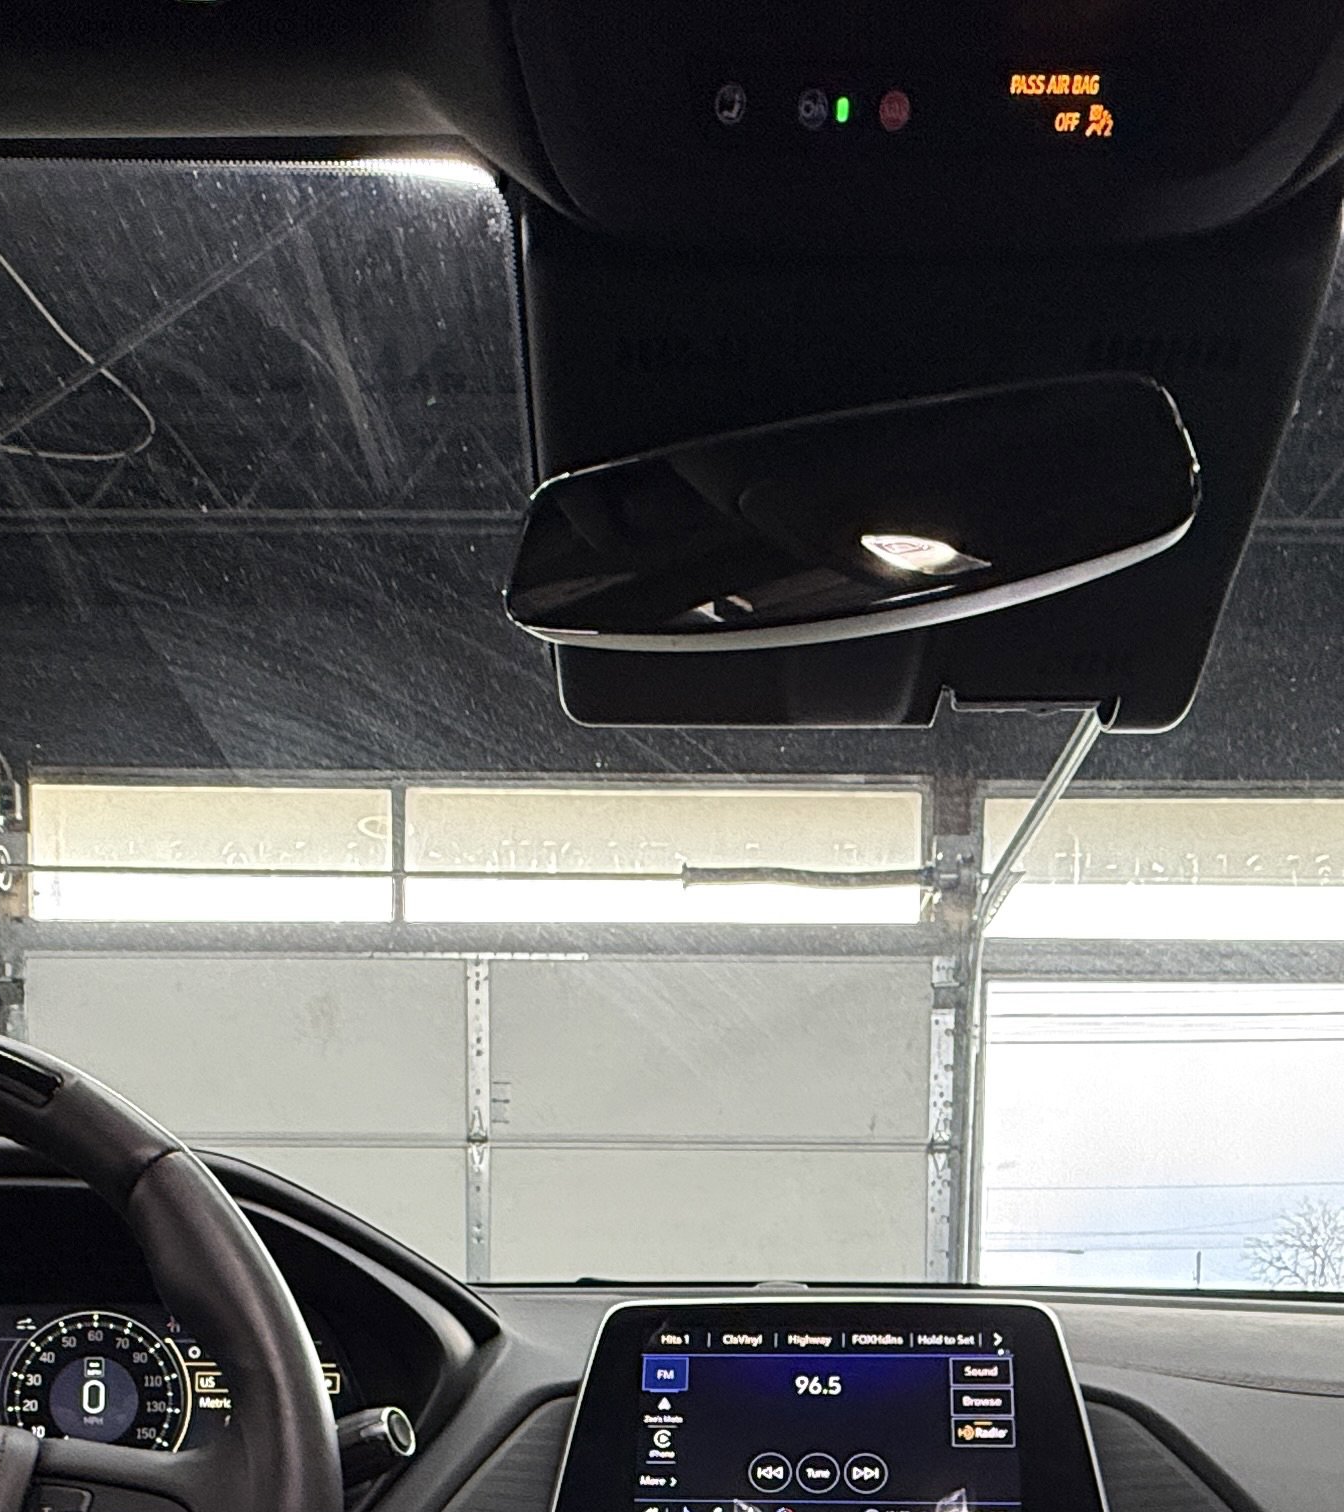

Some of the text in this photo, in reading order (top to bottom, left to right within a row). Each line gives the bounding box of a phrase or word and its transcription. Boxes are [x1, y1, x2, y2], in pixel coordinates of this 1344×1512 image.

[1010, 75, 1100, 94] PASS AIR BAG
[1055, 112, 1080, 132] OFF
[62, 1337, 77, 1348] 50
[87, 1331, 103, 1342] 60
[788, 1334, 832, 1347] Highway
[917, 1334, 975, 1345] Hold to Set
[115, 1338, 130, 1349] 70
[39, 1352, 55, 1364] 40
[133, 1352, 148, 1364] 90
[657, 1370, 675, 1380] FM
[964, 1366, 998, 1377] Sound
[26, 1374, 42, 1386] 30
[144, 1375, 162, 1387] 110
[200, 1377, 216, 1388] US
[794, 1376, 842, 1395] 96.5
[82, 1379, 106, 1414] 0
[962, 1396, 1002, 1407] Browse
[23, 1400, 38, 1412] 20
[146, 1401, 166, 1413] 130
[199, 1397, 232, 1409] Metric
[136, 1428, 156, 1440] 150
[806, 1468, 831, 1479] Tune
[639, 1474, 667, 1487] More
